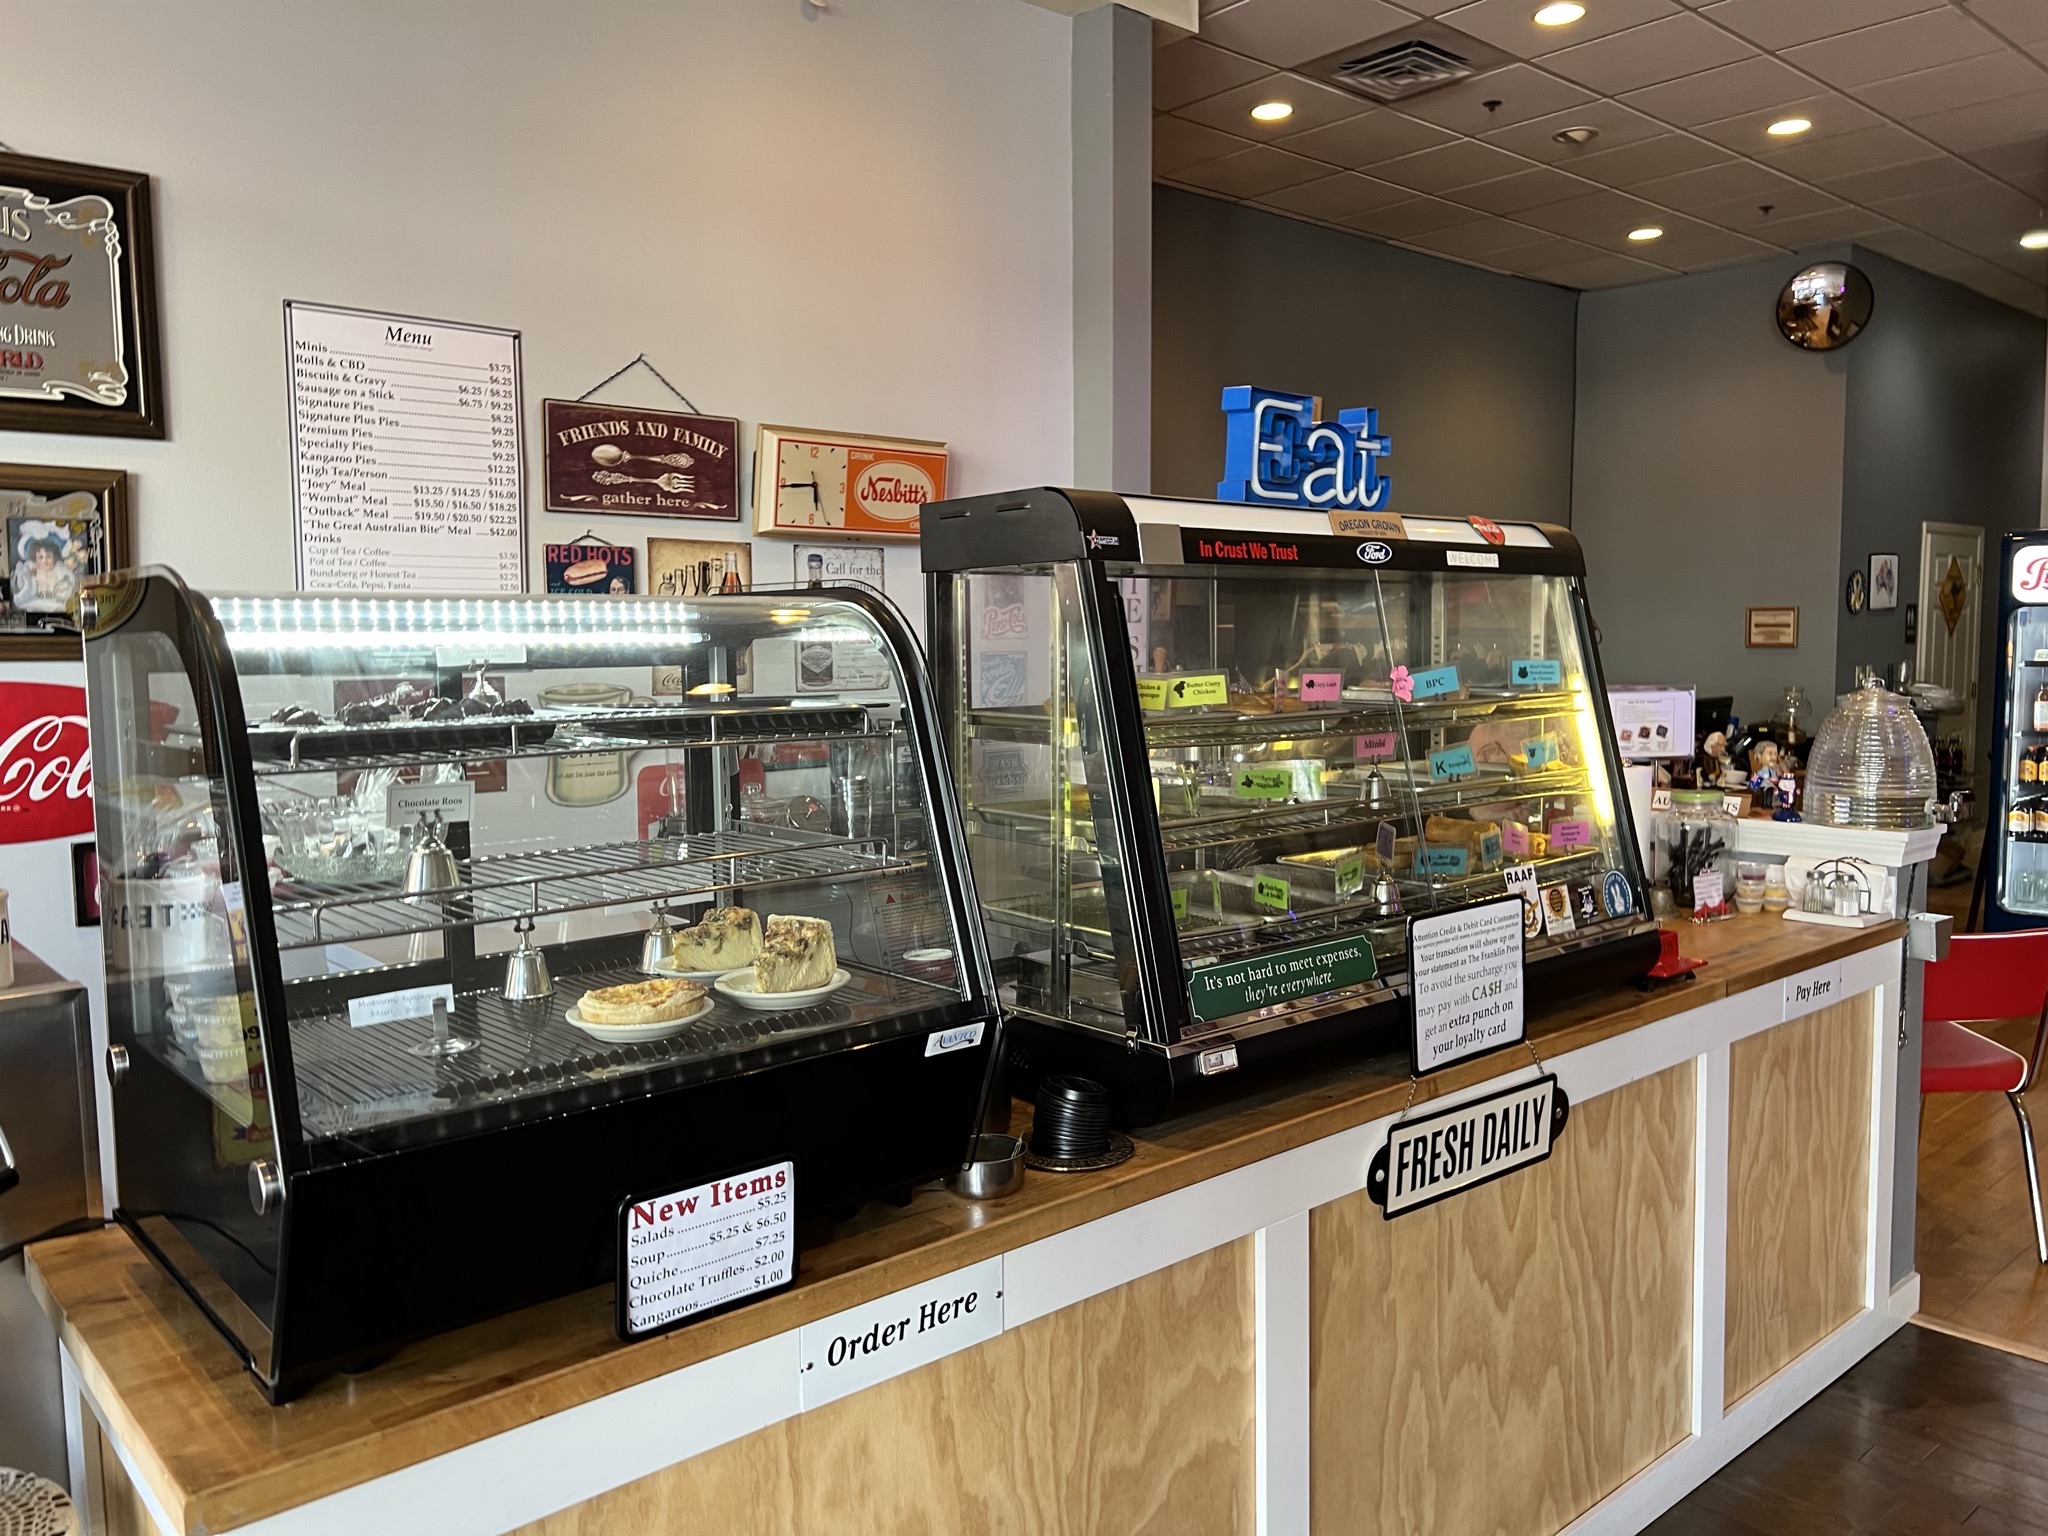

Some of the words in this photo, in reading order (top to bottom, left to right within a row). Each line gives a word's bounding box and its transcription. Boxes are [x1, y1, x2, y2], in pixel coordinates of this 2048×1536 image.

[14, 324, 56, 347] DRINK
[385, 326, 433, 345] Menu
[295, 341, 328, 353] Minis
[489, 363, 512, 373] $3.75
[297, 369, 339, 381] Biscuits
[342, 373, 351, 382] &
[354, 375, 387, 388] Gravy
[459, 385, 482, 395] $6.25
[490, 388, 513, 398] $8.25
[297, 396, 350, 410] Signature
[354, 401, 374, 411] Pies
[299, 424, 348, 436] Premium
[352, 427, 373, 438] Pies
[492, 439, 515, 450] $9.75
[557, 420, 630, 447] FRIENDS
[635, 421, 668, 438] AND
[674, 427, 729, 459] FAMILY
[1217, 386, 1391, 511] Eat
[300, 451, 352, 465] Kangaroo
[355, 455, 377, 466] Pies
[488, 464, 516, 474] $12.25
[810, 447, 819, 458] 12
[301, 465, 328, 477] High
[331, 467, 388, 479] Tea/Person
[488, 477, 516, 487] $11.75
[340, 481, 366, 491] Meal
[413, 485, 442, 495] $13.25
[451, 487, 480, 497] $14.25
[489, 490, 517, 500] $16.00
[602, 492, 652, 505] gather
[657, 494, 690, 508] here
[840, 483, 845, 494] 3
[861, 476, 927, 504] Nesbitt's
[333, 521, 362, 531] Great
[365, 522, 417, 533] Australian
[448, 525, 471, 535] Meal
[490, 527, 517, 538] $42.00
[1339, 518, 1370, 531] OREGON
[1371, 519, 1401, 533] GROWN
[304, 533, 341, 544] Drinks
[548, 545, 582, 563] RED
[586, 547, 632, 565] HOTS
[1200, 541, 1212, 559] In
[1213, 543, 1248, 561] Crust
[1250, 544, 1267, 560] We
[1269, 544, 1299, 561] Trust
[1364, 544, 1386, 560] Ford
[1449, 552, 1498, 566] WELCOME
[826, 562, 846, 575] Call
[850, 563, 863, 575] for
[867, 563, 881, 575] the
[1425, 677, 1445, 689] BPC
[1435, 761, 1446, 775] K
[398, 798, 440, 808] Chocolate
[442, 797, 463, 805] Roos
[1506, 868, 1533, 884] RAAF
[1414, 931, 1438, 943] Attention
[1440, 926, 1456, 936] Credit
[1463, 920, 1479, 931] Debit
[1480, 917, 1493, 927] Card
[1494, 912, 1519, 924] Customers
[1420, 951, 1435, 963] Your
[1436, 945, 1468, 959] transaction
[1470, 939, 1481, 950] will
[1483, 937, 1498, 948] show
[1500, 935, 1507, 945] up
[1508, 933, 1515, 941] on
[1204, 976, 1223, 991] It's
[1226, 971, 1246, 987] not
[1247, 963, 1273, 982] hard
[1275, 962, 1286, 974] to
[1290, 957, 1314, 972] meet
[1316, 946, 1362, 968] expenses,
[1414, 967, 1430, 980] your
[1431, 958, 1459, 974] statement
[1468, 953, 1480, 964] The
[1481, 947, 1505, 961] Franklin
[1506, 944, 1520, 955] Press
[1245, 982, 1278, 1004] they're
[1280, 971, 1335, 994] everywhere.
[1418, 983, 1429, 994] To
[1430, 977, 1452, 992] avoid
[1454, 974, 1466, 985] the
[1467, 965, 1503, 982] surcharge
[1504, 960, 1517, 974] you
[1418, 1004, 1436, 1019] may
[1438, 1000, 1451, 1016] pay
[1453, 994, 1470, 1006] with
[1471, 980, 1502, 1001] CA$H
[1504, 978, 1518, 991] and
[1796, 985, 1811, 1002] Pay
[1813, 980, 1830, 997] Here
[1424, 1025, 1437, 1041] get
[1438, 1023, 1448, 1033] an
[1449, 1013, 1470, 1029] extra
[1472, 1003, 1500, 1025] punch
[1502, 1000, 1514, 1011] on
[933, 1028, 977, 1048] AVANTCO
[1433, 1036, 1453, 1060] your
[1455, 1024, 1486, 1048] loyalty
[1487, 1019, 1506, 1037] card
[1395, 1118, 1476, 1198] FRESH
[1481, 1094, 1546, 1167] DAILY
[632, 1195, 700, 1231] New
[710, 1169, 786, 1208] Items
[631, 1225, 674, 1248] Salads
[757, 1192, 787, 1210] $5.25
[630, 1250, 666, 1269] Soup
[709, 1225, 739, 1245] $5.25
[742, 1221, 753, 1233] &
[757, 1211, 787, 1229] $6.50
[630, 1266, 679, 1290] Quiche
[755, 1231, 785, 1249] $7.25
[629, 1283, 695, 1310] Chocolate
[698, 1260, 745, 1287] Truffles
[754, 1250, 784, 1269] $2.00
[629, 1300, 699, 1330] Kangaroos
[754, 1269, 783, 1289] $1.00
[828, 1317, 911, 1367] Order
[918, 1291, 978, 1334] Here
